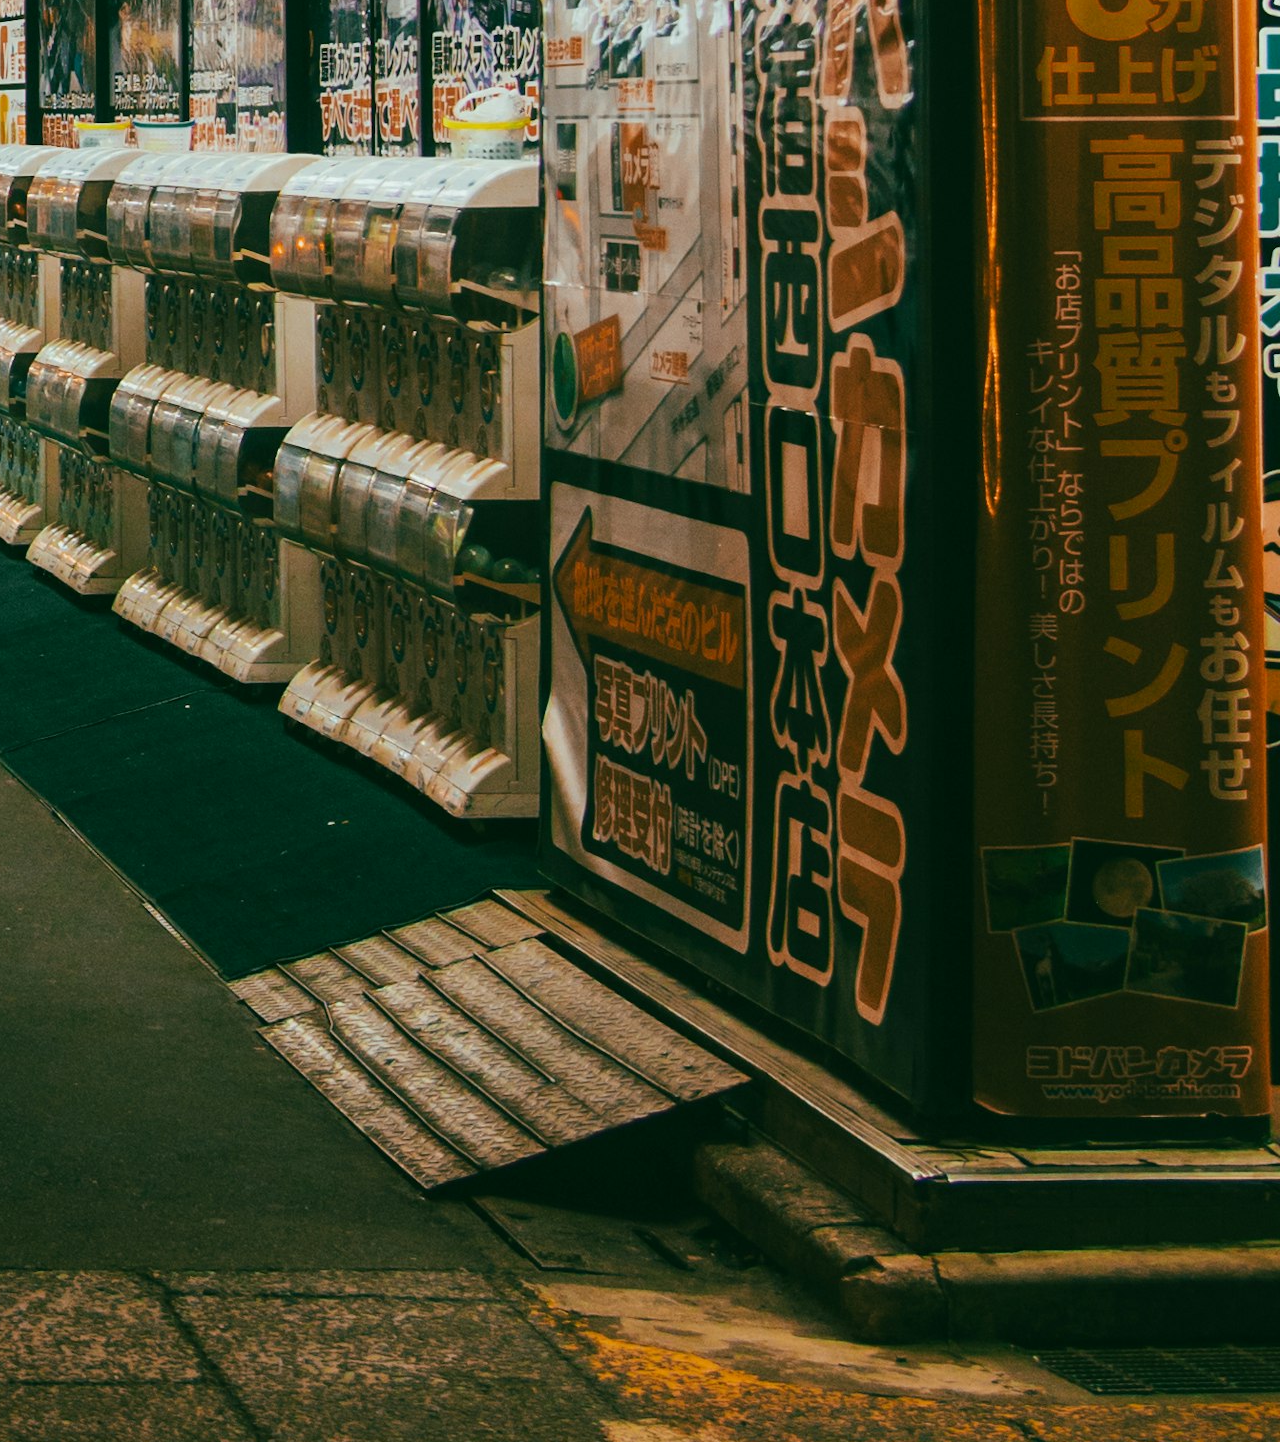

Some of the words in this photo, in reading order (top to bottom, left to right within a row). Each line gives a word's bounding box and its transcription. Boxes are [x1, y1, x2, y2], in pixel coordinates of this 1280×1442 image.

[1035, 44, 1220, 107] 仕上げ
[1051, 250, 1087, 615] 「お店プリント」ならではの
[1089, 133, 1191, 820] 高品質プリント
[1190, 135, 1253, 802] デジタルもフィルムもお任せ
[593, 652, 709, 782] 写真プリント
[592, 751, 673, 876] 修理受付
[1026, 1044, 1254, 1080] ヨドバシカメラ
[1041, 1079, 1241, 1104] www.yodobashi.com
